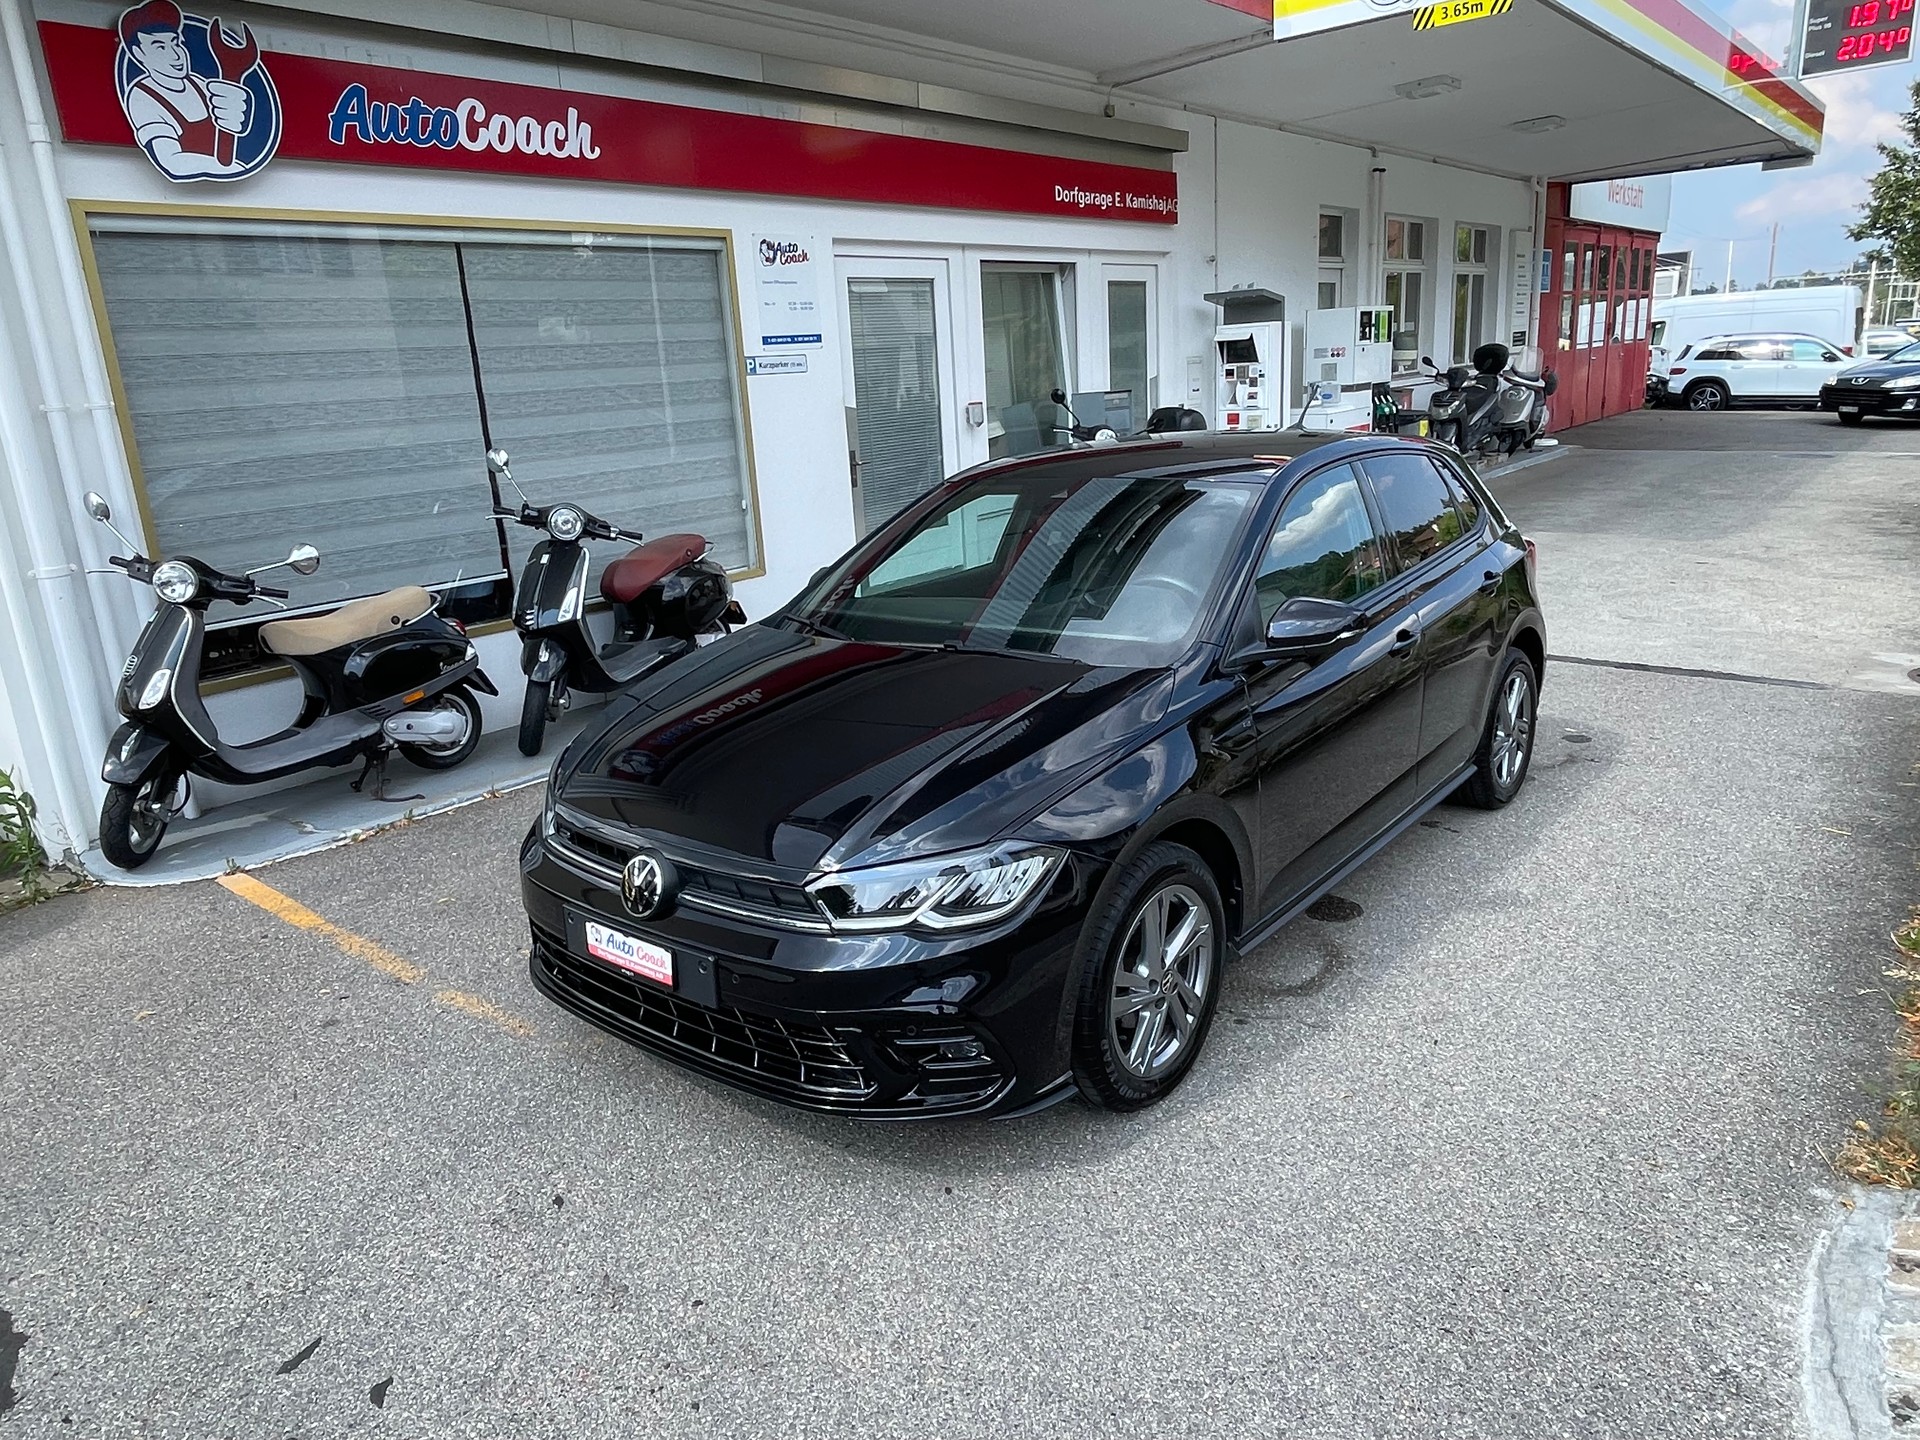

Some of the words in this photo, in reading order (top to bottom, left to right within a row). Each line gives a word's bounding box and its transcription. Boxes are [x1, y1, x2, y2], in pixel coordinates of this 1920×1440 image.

[1441, 1, 1483, 20] 3.65m
[1054, 185, 1113, 210] Dorfgarage
[1115, 191, 1124, 208] E.
[1607, 178, 1644, 209] Werkstatt
[776, 241, 799, 256] Auto
[780, 248, 810, 266] Coach
[606, 933, 635, 958] Auto
[636, 945, 668, 971] Coach
